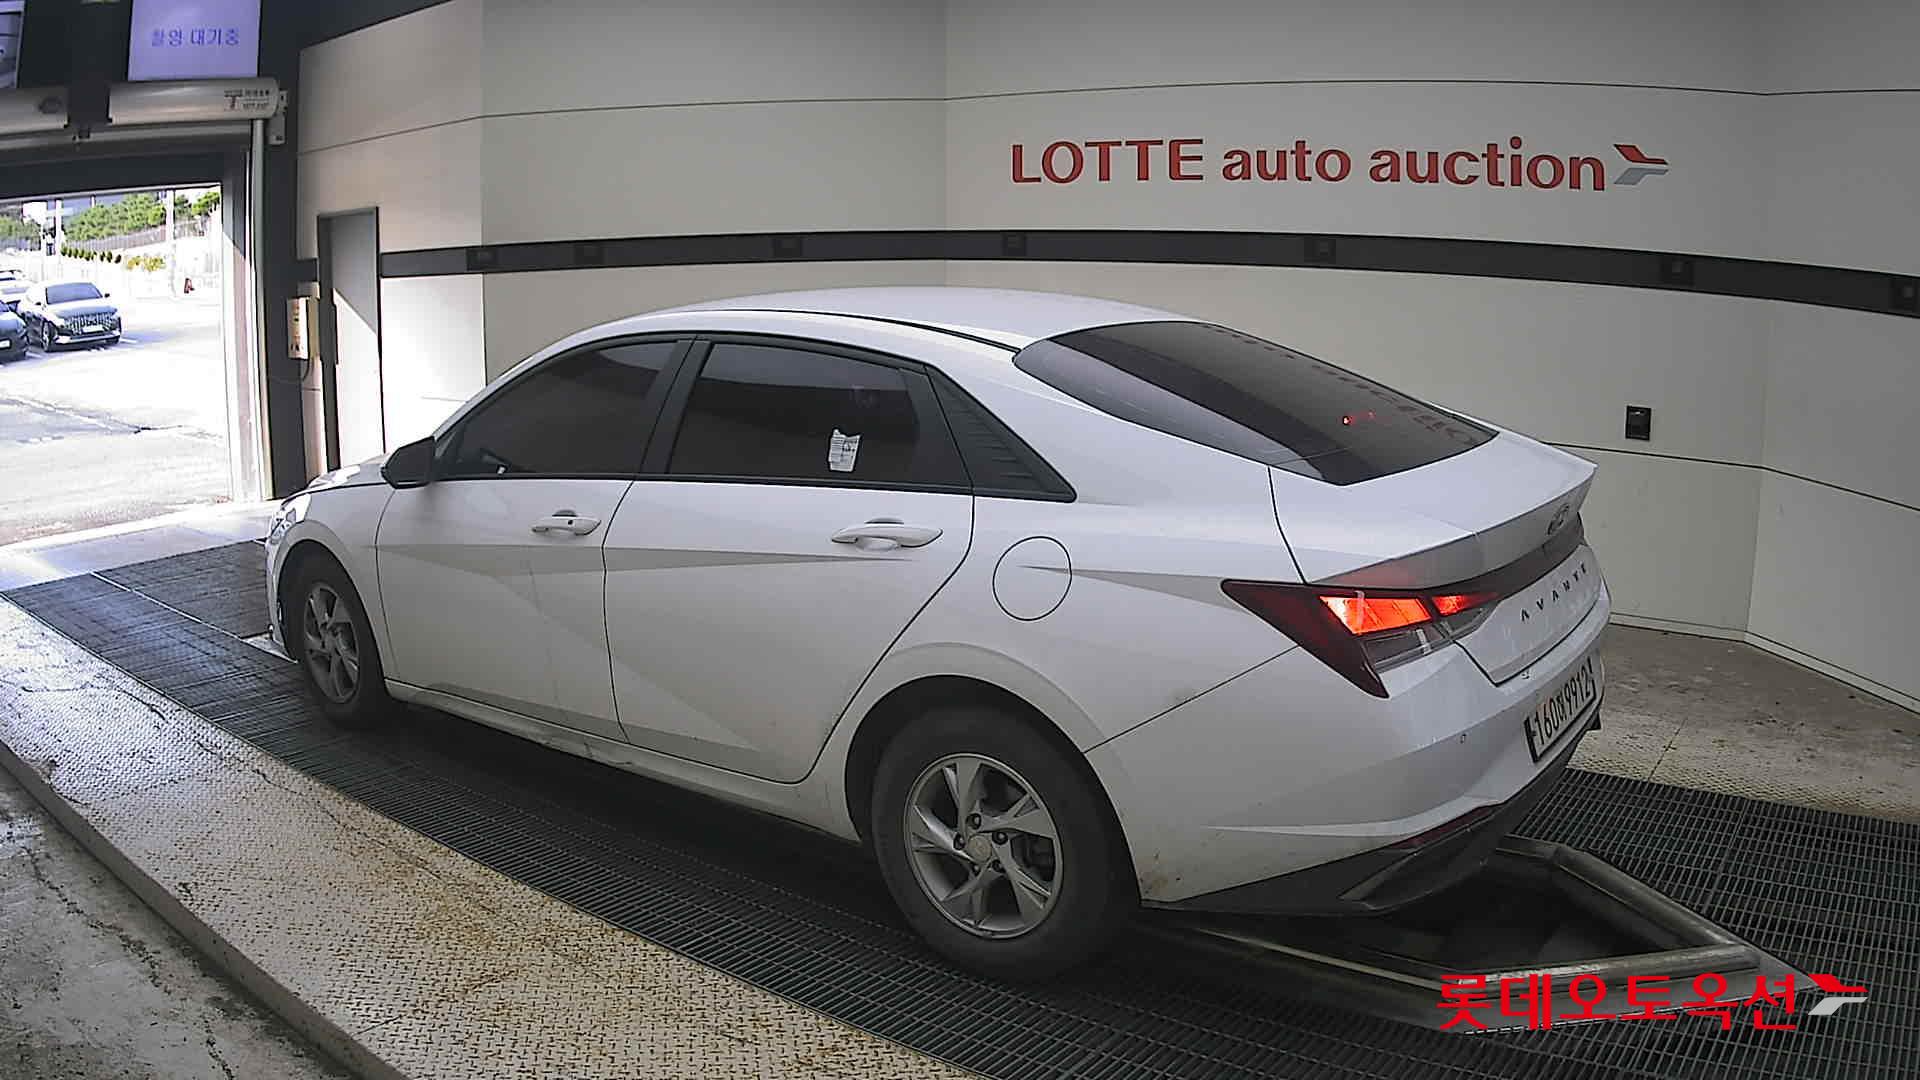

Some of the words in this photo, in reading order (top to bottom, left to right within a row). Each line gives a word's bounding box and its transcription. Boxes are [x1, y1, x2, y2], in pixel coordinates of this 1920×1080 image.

[1011, 138, 1203, 184] LOTTE
[1222, 140, 1351, 182] auto
[1369, 136, 1605, 191] auction
[1520, 563, 1587, 622] AVANTE
